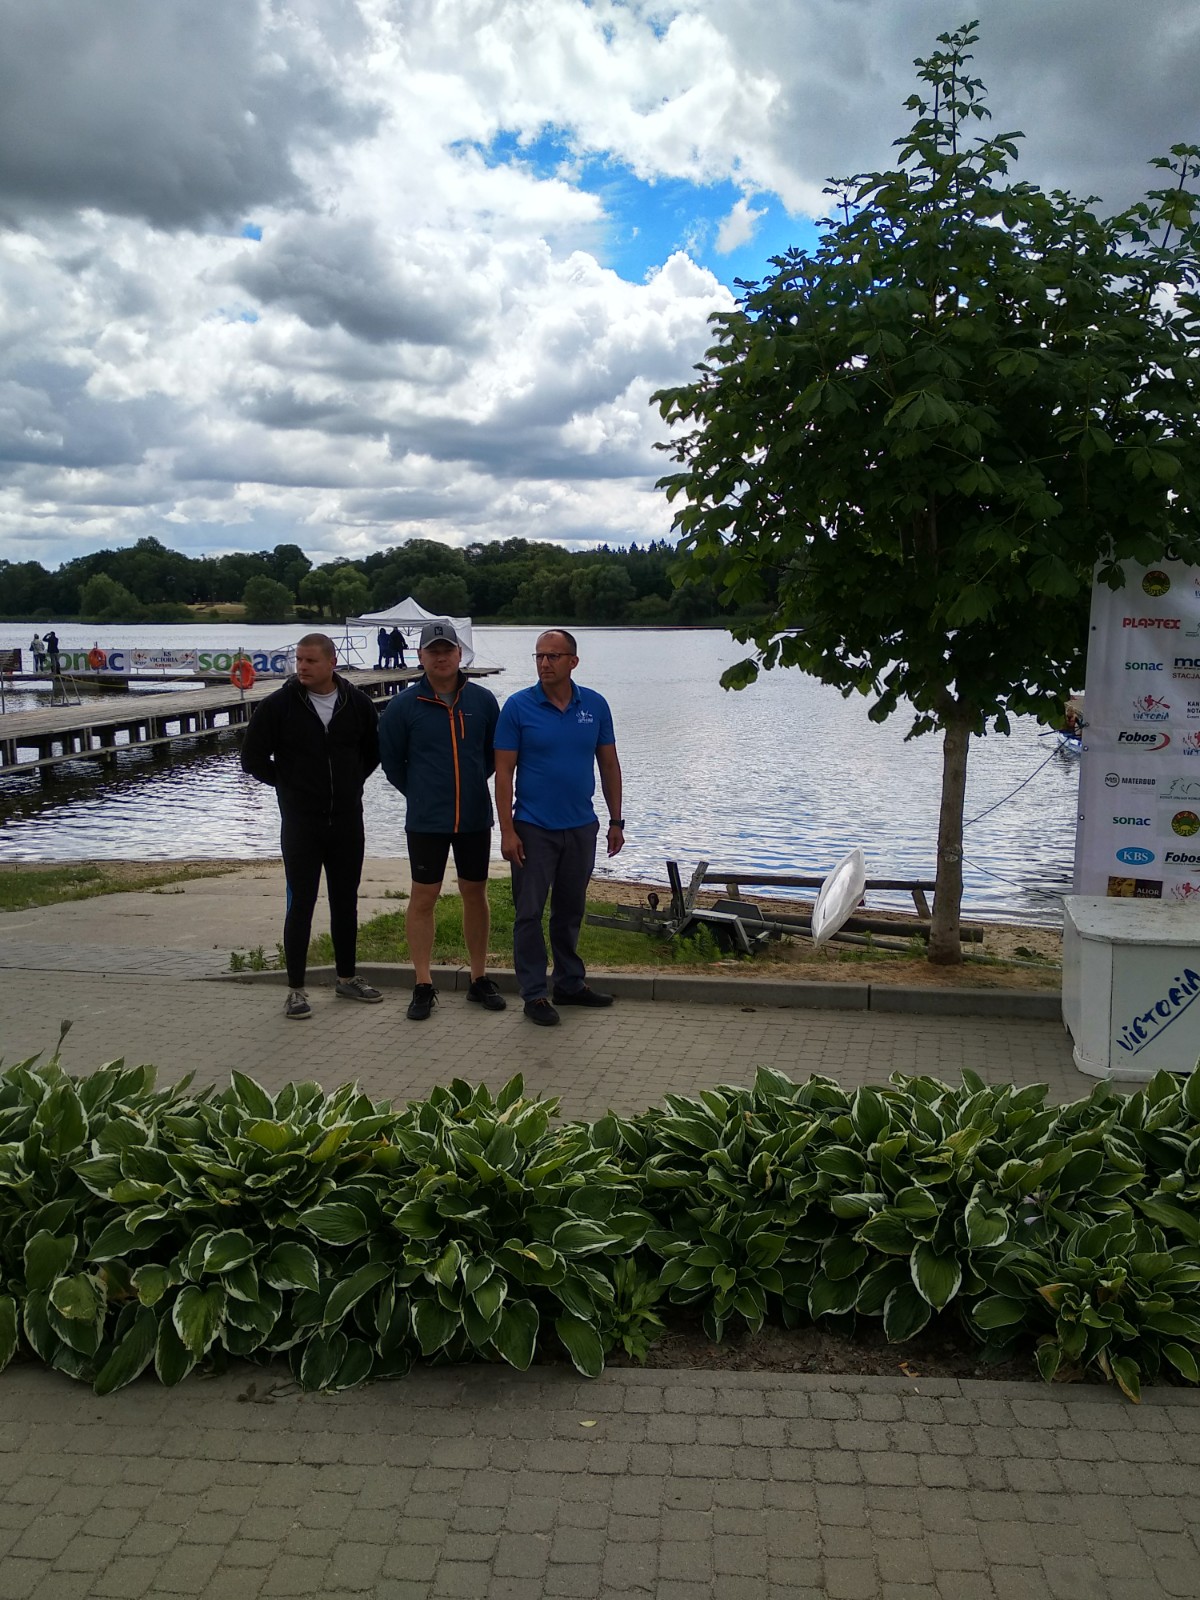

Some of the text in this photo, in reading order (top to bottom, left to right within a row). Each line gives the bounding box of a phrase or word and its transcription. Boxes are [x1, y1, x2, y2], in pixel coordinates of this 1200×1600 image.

[43, 652, 124, 671] onc
[1125, 661, 1164, 671] sonac
[1117, 731, 1157, 742] Fobos
[1113, 816, 1151, 826] sonac
[1123, 851, 1149, 862] KBS
[1136, 887, 1160, 896] ALIOR
